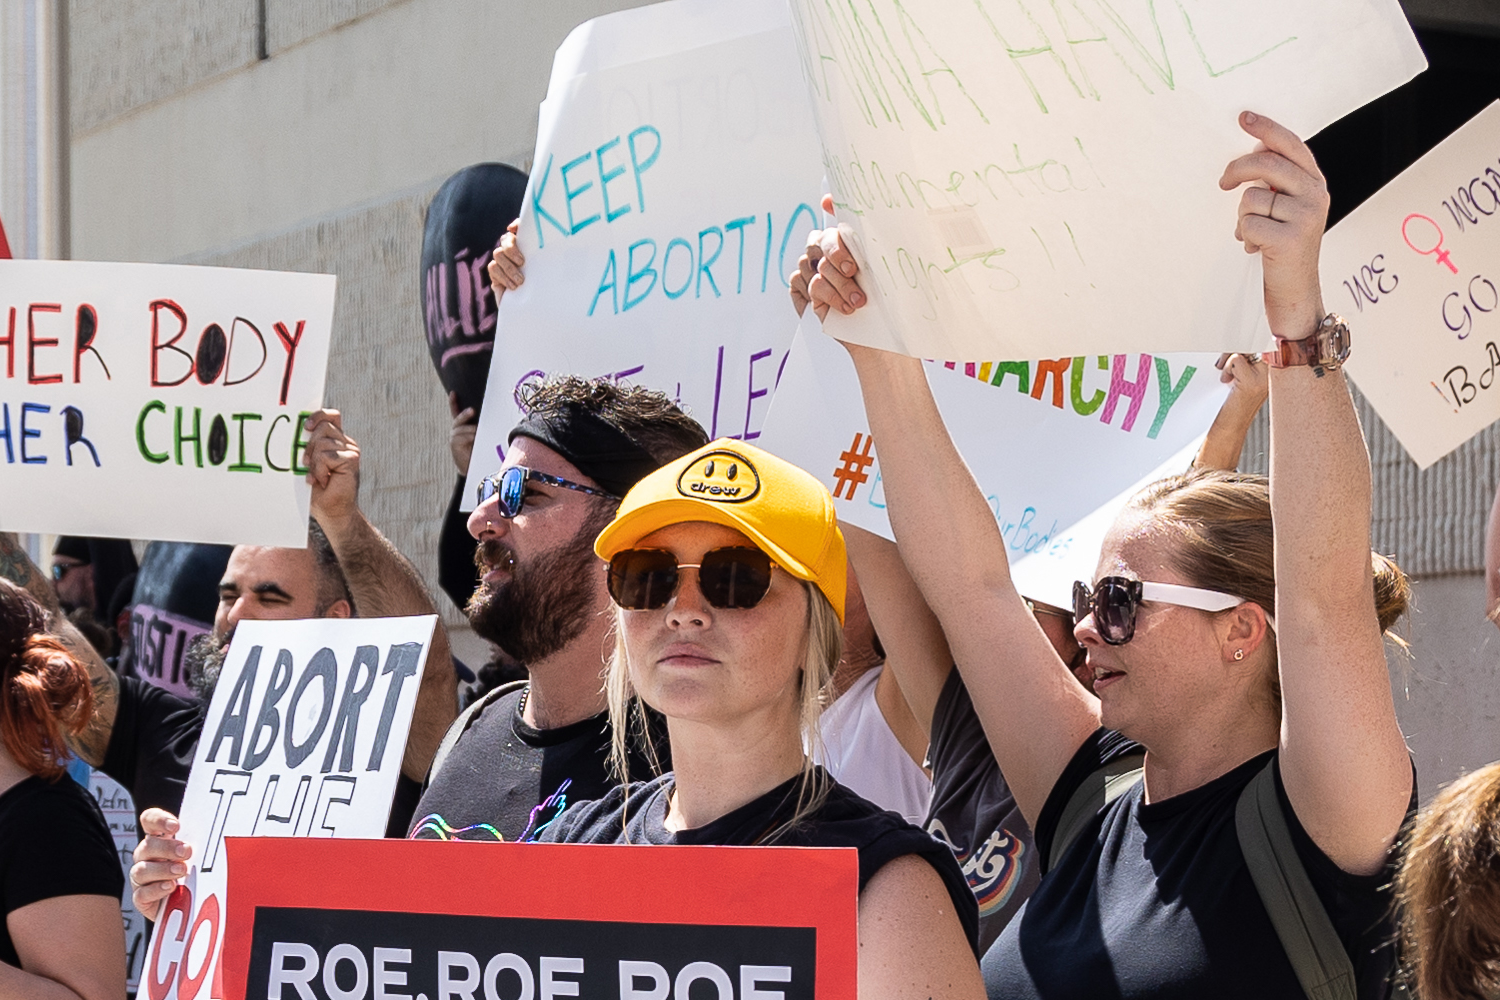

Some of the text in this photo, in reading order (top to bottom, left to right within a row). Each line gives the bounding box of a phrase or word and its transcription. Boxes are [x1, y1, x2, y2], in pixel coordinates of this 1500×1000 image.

[532, 124, 662, 249] KEEP
[586, 202, 820, 317] ABORTIO
[1343, 254, 1399, 313] WE
[1442, 274, 1498, 340] GO
[149, 298, 306, 406] BODY
[711, 345, 790, 441] LE
[1443, 341, 1500, 407] BA
[135, 399, 314, 476] CHOICE
[691, 482, 741, 497] drew
[205, 642, 423, 773] ABORT
[201, 769, 357, 872] THE
